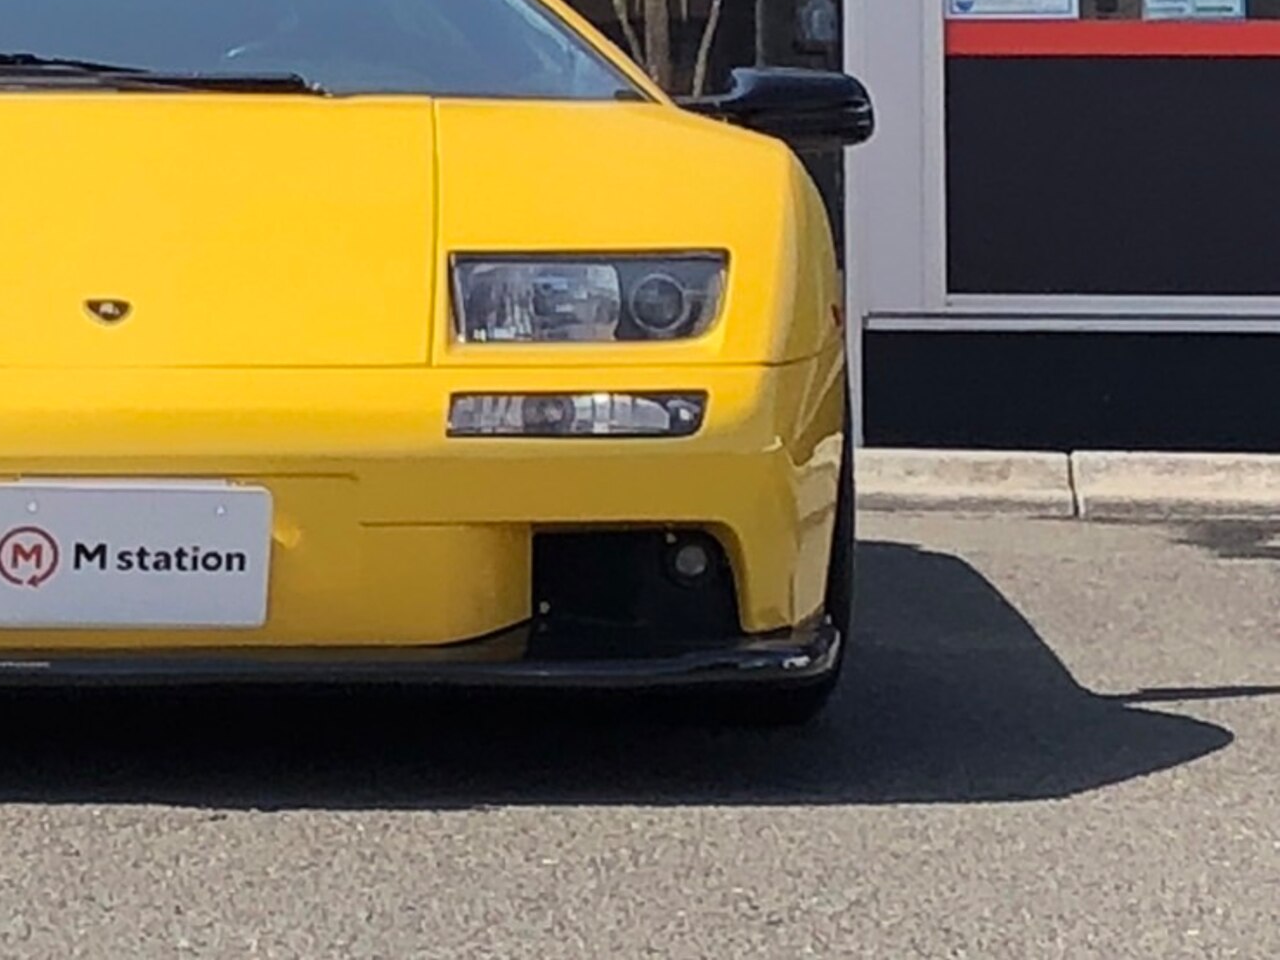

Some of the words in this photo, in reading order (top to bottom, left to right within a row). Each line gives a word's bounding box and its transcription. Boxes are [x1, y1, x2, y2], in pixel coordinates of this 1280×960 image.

[12, 543, 42, 569] M
[73, 543, 107, 570] M
[116, 546, 246, 571] station
